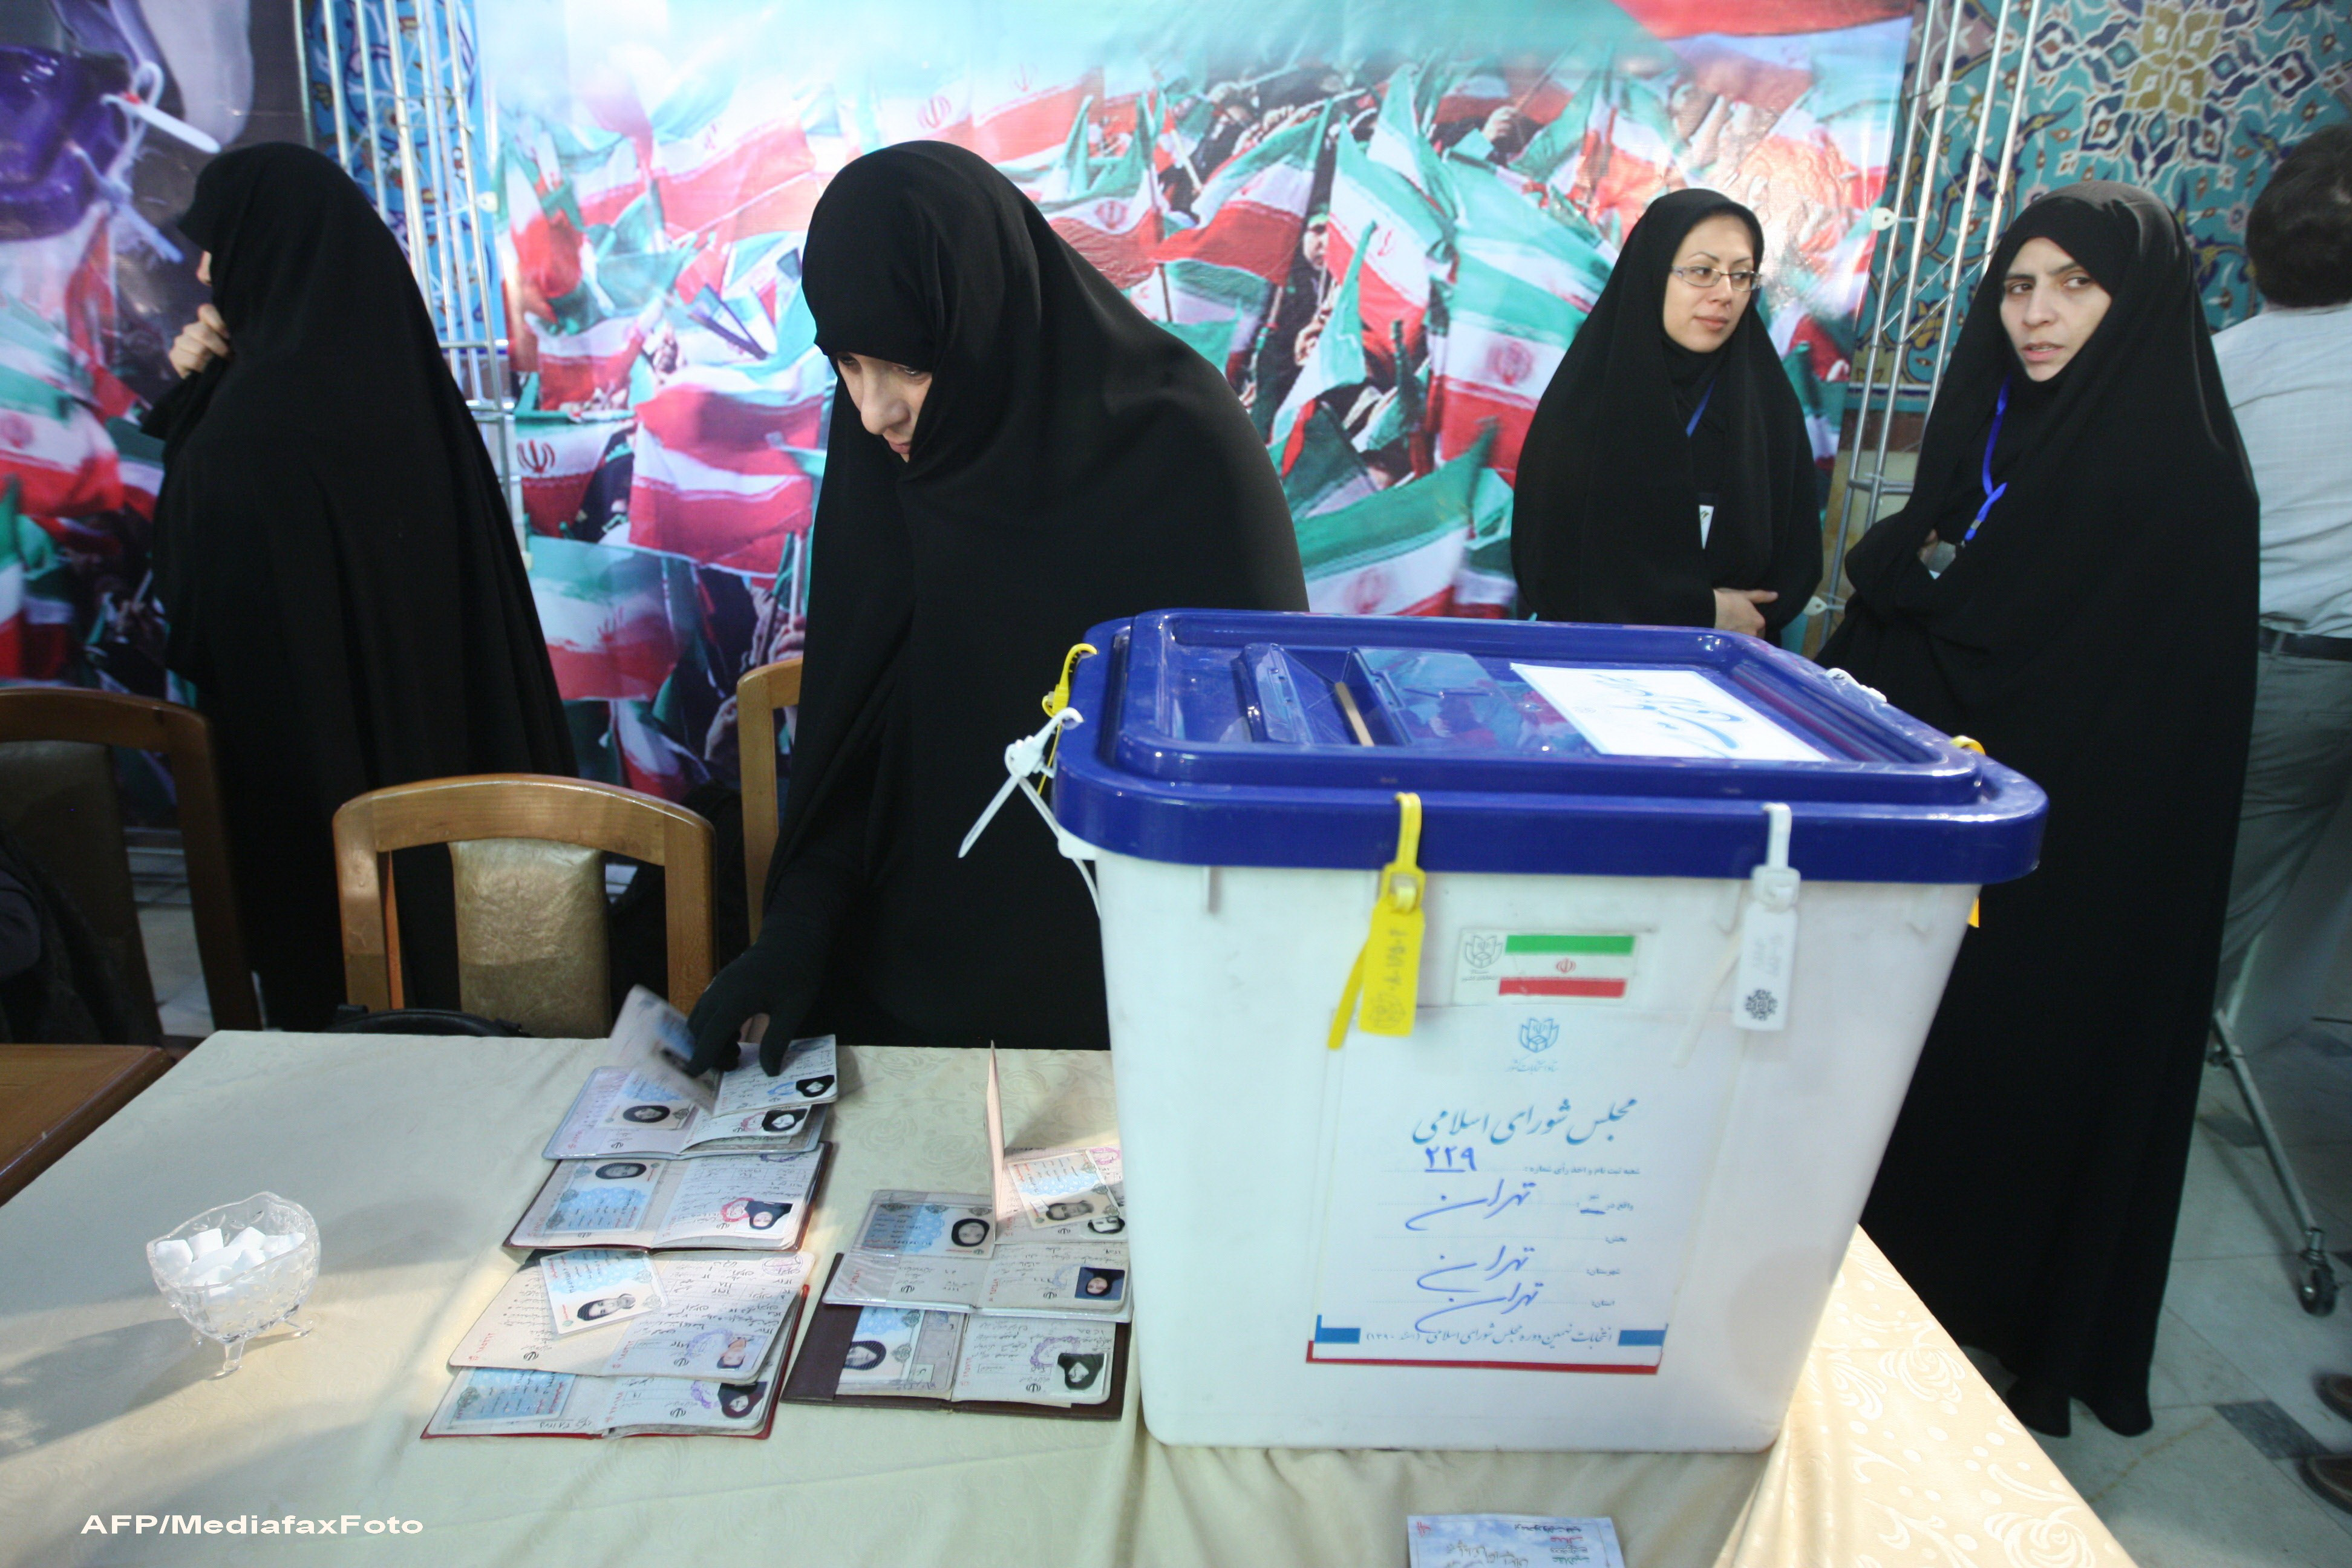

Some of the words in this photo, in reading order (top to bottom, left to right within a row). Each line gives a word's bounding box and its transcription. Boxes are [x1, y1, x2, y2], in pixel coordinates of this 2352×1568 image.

[1413, 1110, 1489, 1145] اسلامی
[1491, 1098, 1572, 1145] شورای
[1566, 1098, 1638, 1145] مجلس
[1405, 1178, 1537, 1232] تهران
[1416, 1244, 1536, 1293] تهران
[1414, 1282, 1544, 1334] تهران
[1426, 1328, 1460, 1345] اسلامی
[1460, 1322, 1497, 1344] شورای
[1492, 1325, 1523, 1344] مجلس
[1572, 1326, 1612, 1350] انتخابات
